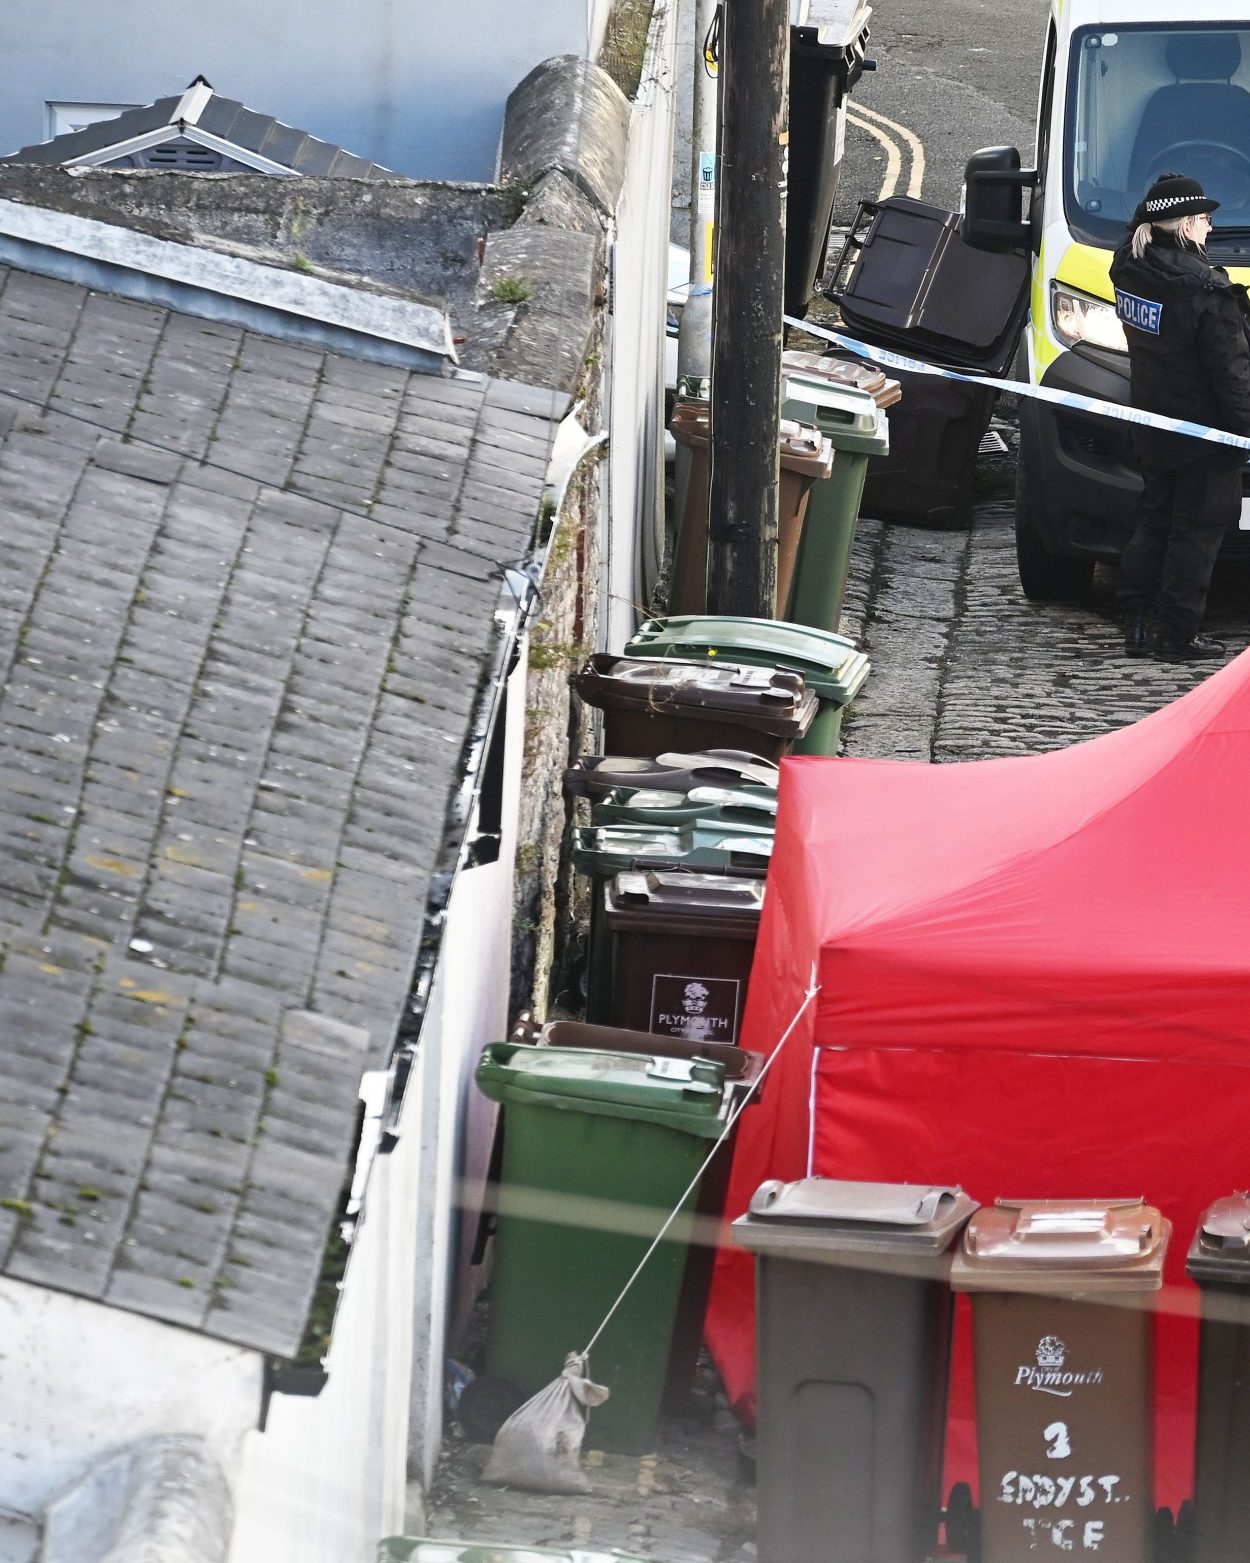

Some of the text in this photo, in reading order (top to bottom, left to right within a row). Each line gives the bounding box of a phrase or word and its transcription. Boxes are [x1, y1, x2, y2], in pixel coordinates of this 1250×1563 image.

[1116, 294, 1158, 329] POLICE
[878, 349, 925, 371] POLICE
[1014, 1366, 1104, 1395] Plymouth
